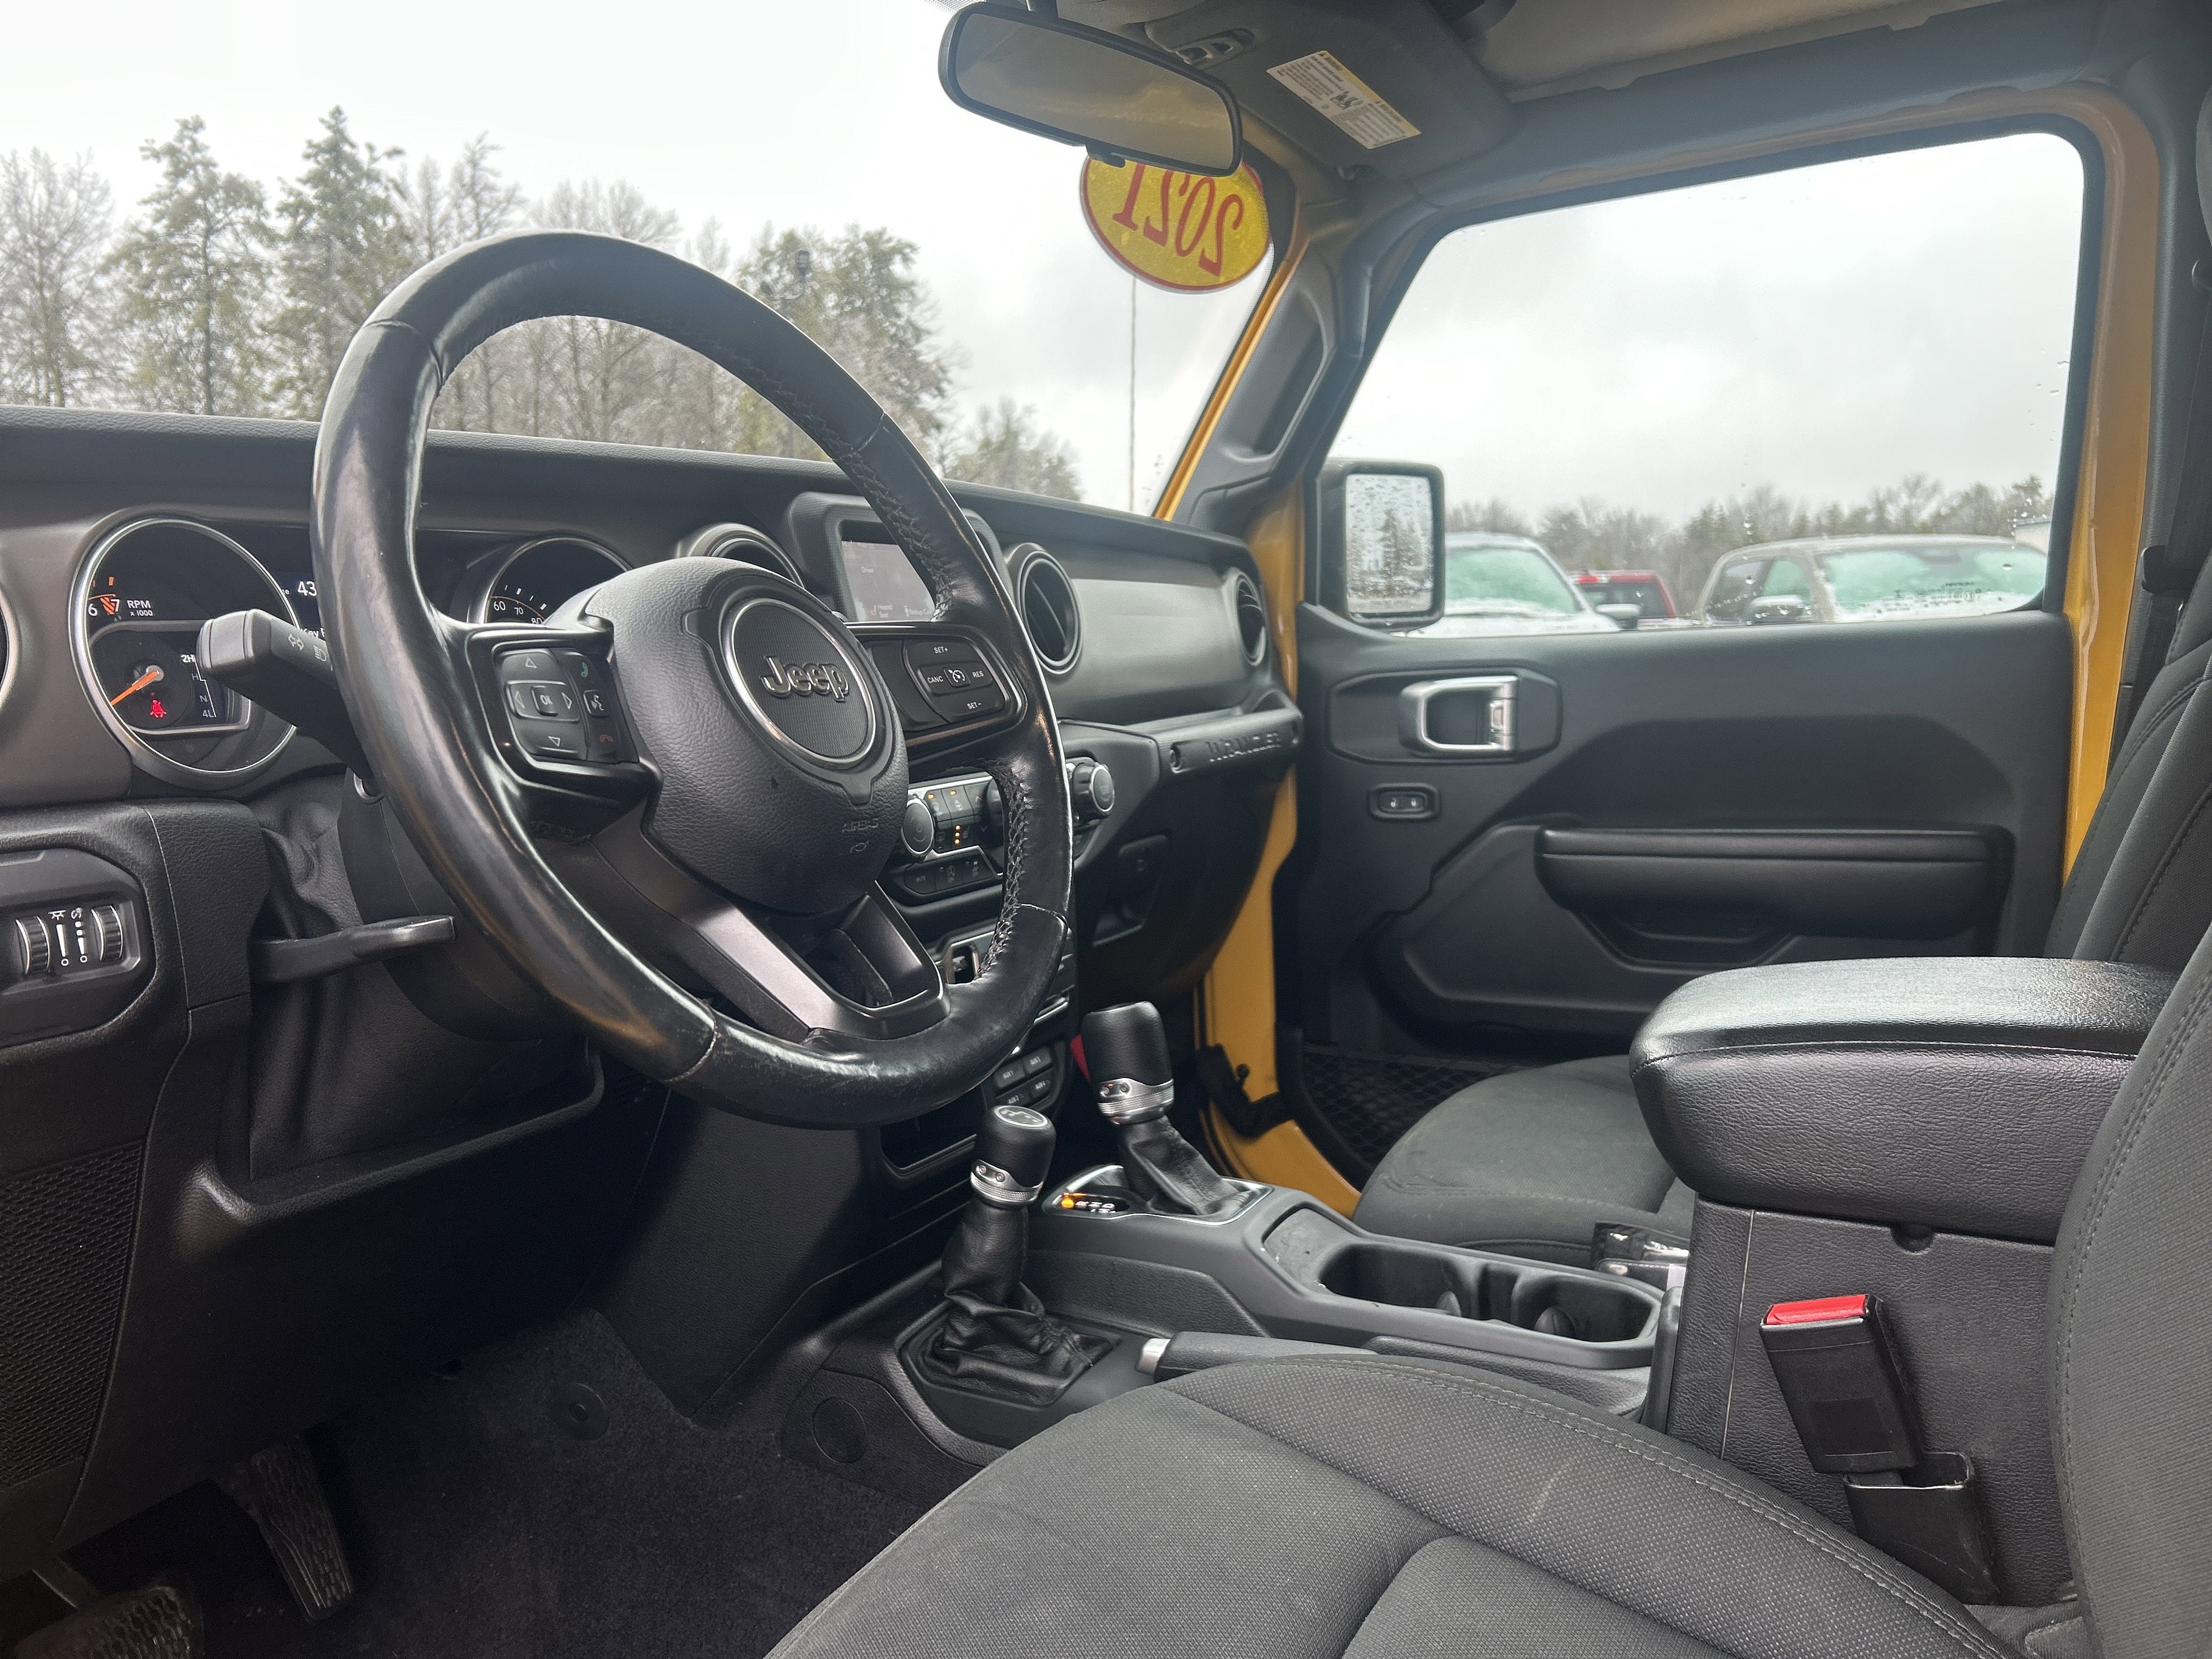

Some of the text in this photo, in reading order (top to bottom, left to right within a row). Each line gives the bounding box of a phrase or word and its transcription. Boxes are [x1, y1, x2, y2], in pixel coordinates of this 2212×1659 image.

[111, 599, 120, 612] 7
[127, 600, 151, 608] RPM
[494, 601, 506, 611] 60
[88, 603, 98, 616] 6
[514, 607, 524, 616] 70
[180, 654, 195, 663] 2H
[760, 657, 849, 702] Jeep
[540, 695, 553, 705] OK
